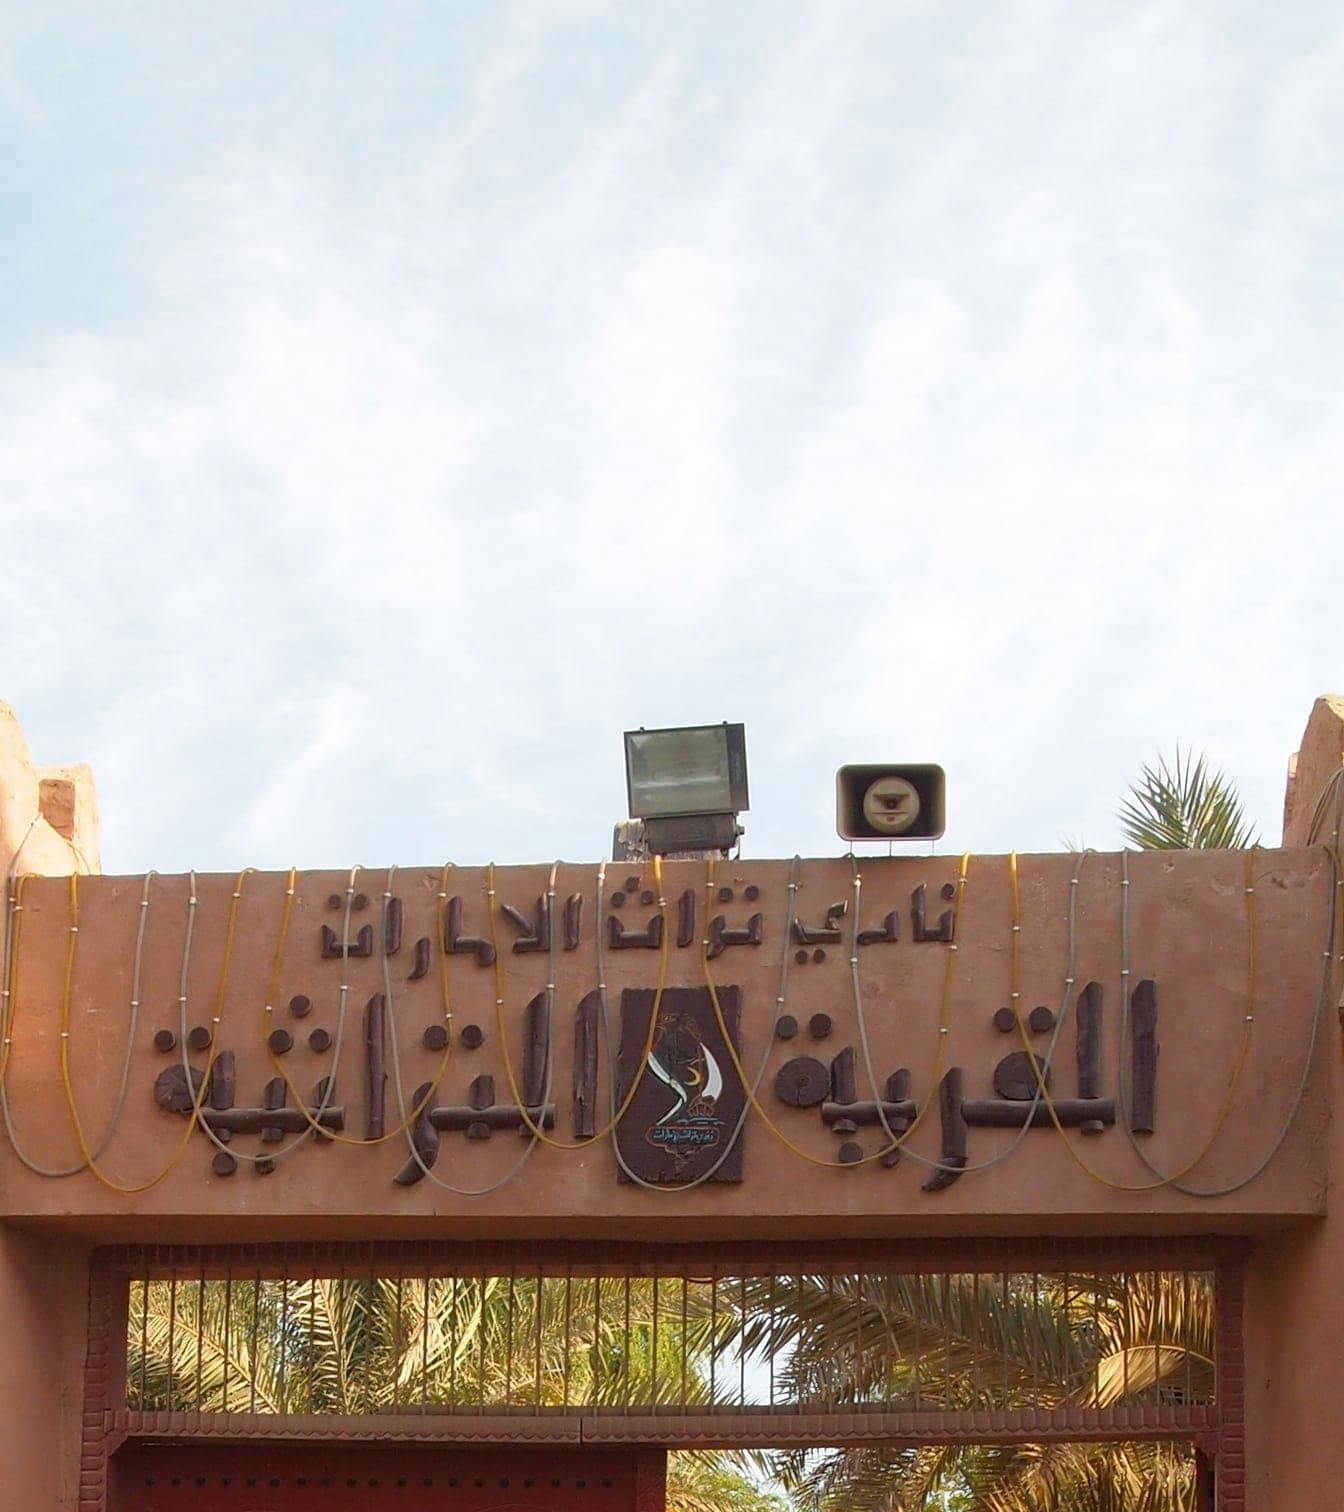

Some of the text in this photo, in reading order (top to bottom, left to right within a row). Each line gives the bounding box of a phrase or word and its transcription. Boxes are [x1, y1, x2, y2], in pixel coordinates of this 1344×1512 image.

[320, 874, 958, 982] نادي تراث الامارات
[153, 978, 1161, 1193] القرية التراثية
